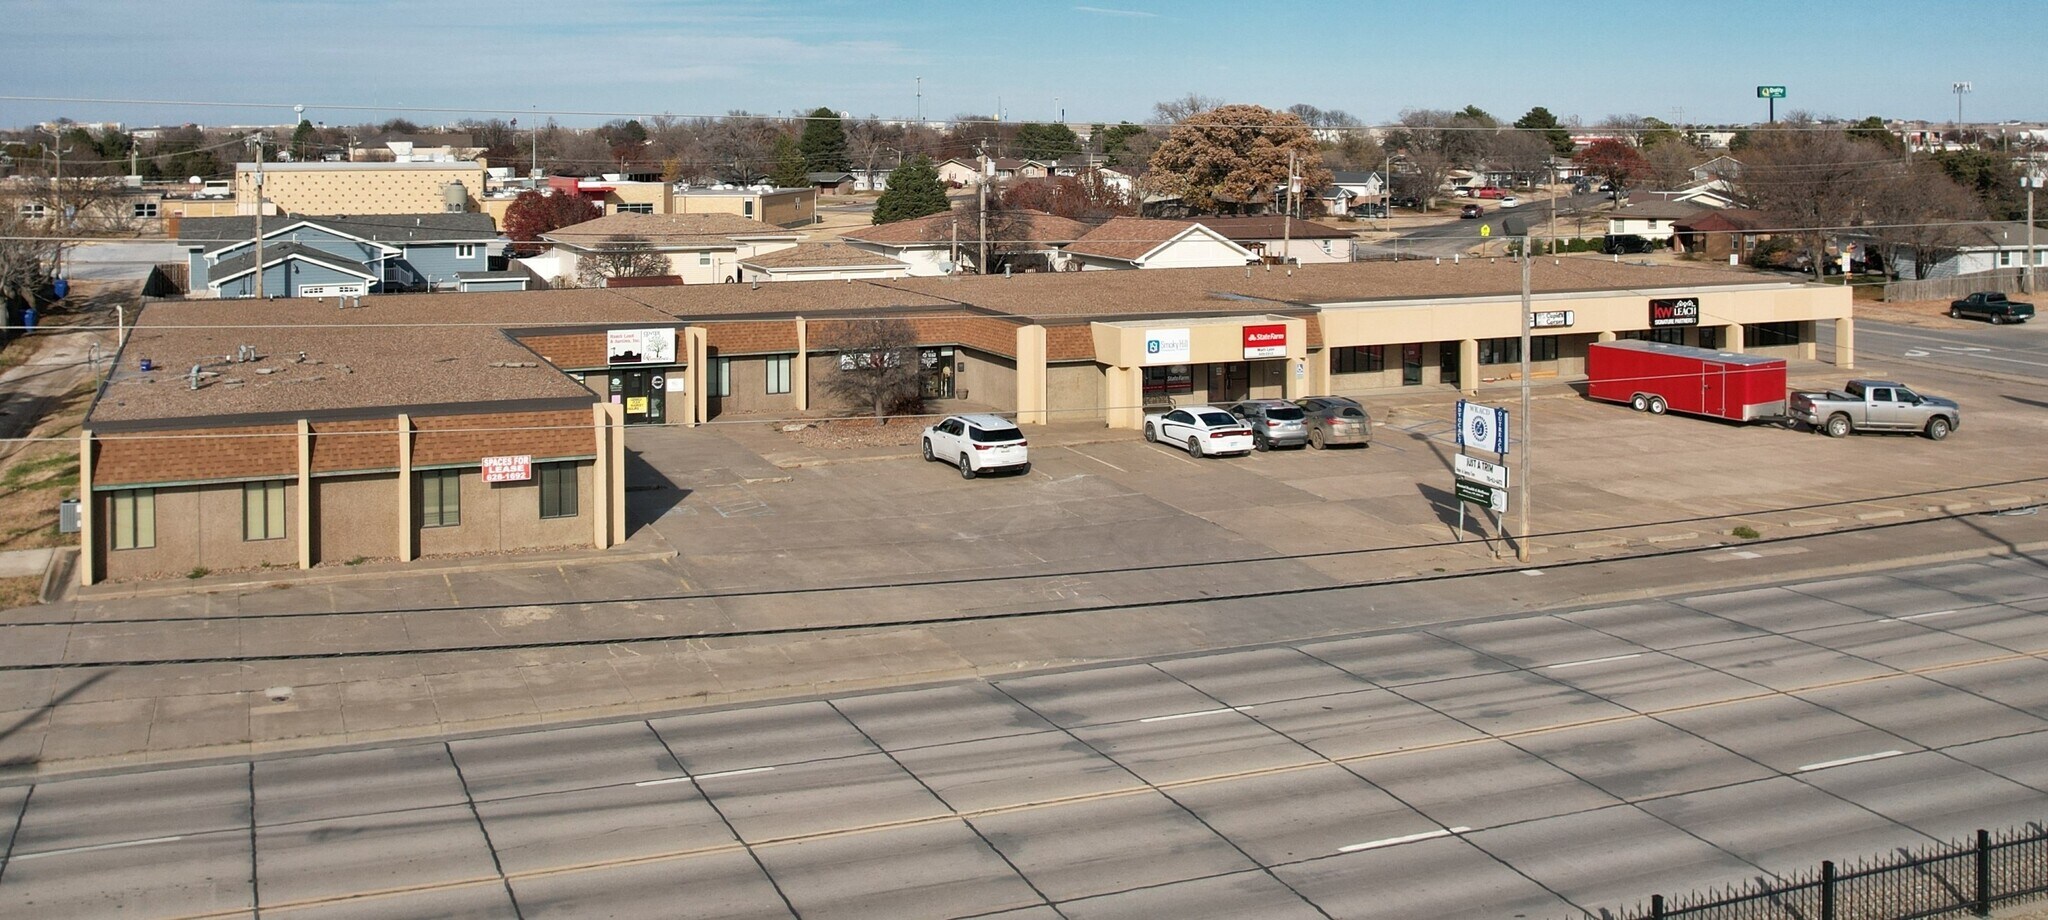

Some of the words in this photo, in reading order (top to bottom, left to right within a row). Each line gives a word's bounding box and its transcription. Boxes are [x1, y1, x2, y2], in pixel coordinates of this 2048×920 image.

[1654, 303, 1673, 318] kw
[1674, 307, 1697, 316] LEACH
[1161, 340, 1179, 350] Smoky
[1179, 339, 1189, 348] Hill
[484, 458, 512, 466] SPACES
[513, 456, 529, 465] FOR
[1466, 458, 1477, 468] JUST
[1477, 460, 1481, 469] A
[1482, 462, 1494, 473] TRIM
[489, 465, 524, 473] LEASE
